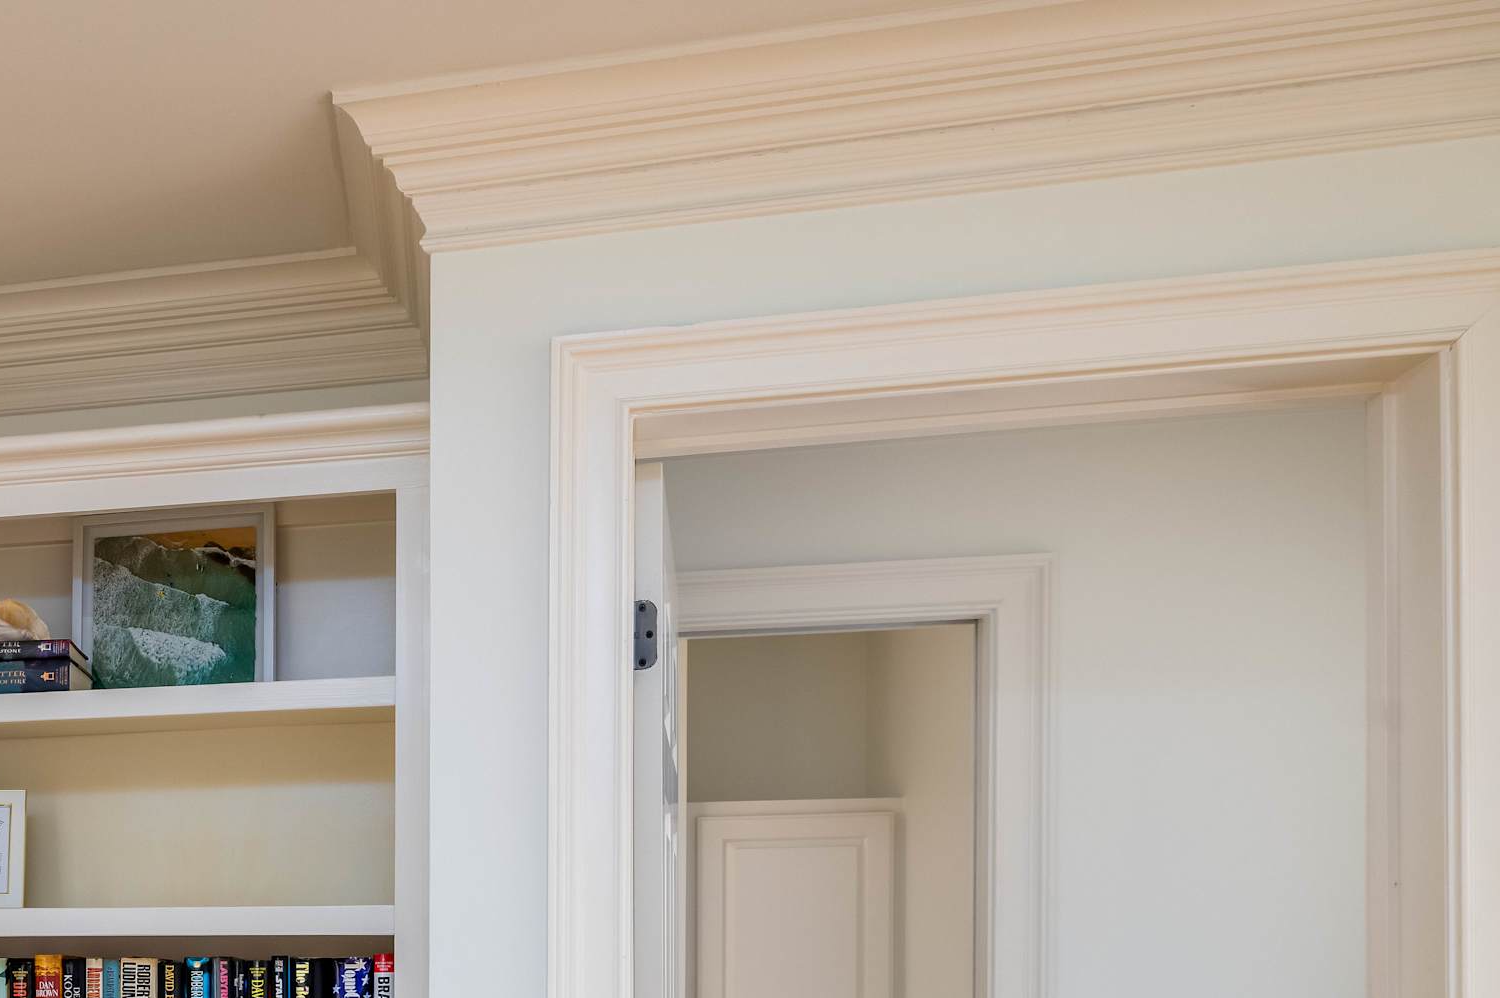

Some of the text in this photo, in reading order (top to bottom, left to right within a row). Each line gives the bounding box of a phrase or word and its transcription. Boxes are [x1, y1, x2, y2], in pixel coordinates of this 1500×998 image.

[39, 981, 54, 989] DAN
[165, 964, 175, 991] DAVID
[190, 970, 203, 998] ROBERT
[295, 962, 309, 983] The
[344, 961, 365, 991] Tom
